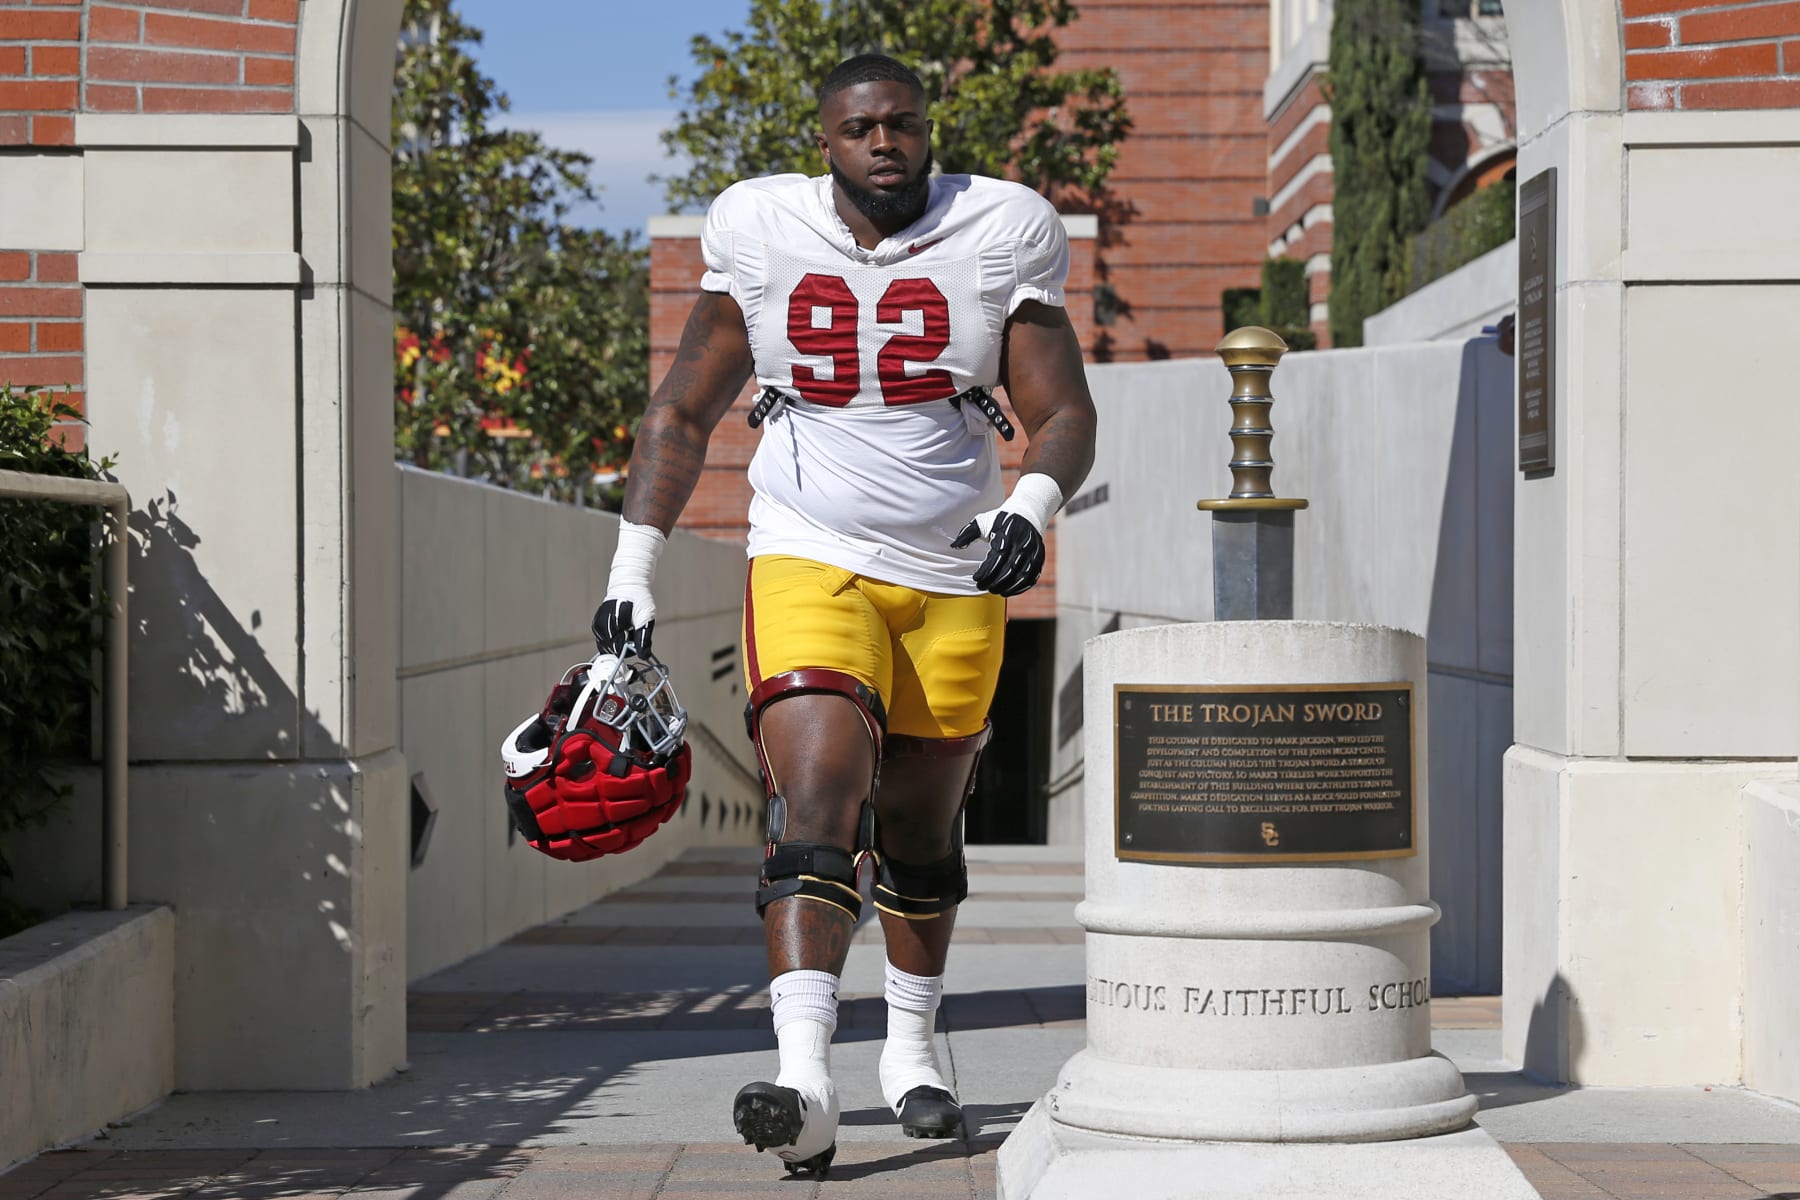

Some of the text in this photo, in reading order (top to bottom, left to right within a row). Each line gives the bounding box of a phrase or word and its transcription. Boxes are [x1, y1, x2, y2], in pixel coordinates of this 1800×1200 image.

[786, 273, 957, 408] 92
[1150, 702, 1384, 727] THE TROJAN SWORD
[1148, 736, 1165, 745] THIS
[1166, 736, 1199, 745] COLUMN
[1202, 737, 1209, 745] IS
[1211, 737, 1259, 745] DEDICATED
[1261, 736, 1273, 745] TO
[1275, 736, 1298, 745] MARK
[1337, 735, 1356, 744] WHO
[1371, 735, 1384, 743] THE
[1147, 748, 1200, 756] DEVELOPMENT
[1201, 748, 1220, 756] AND
[1221, 748, 1276, 756] COMPLETION
[1278, 748, 1290, 756] OF
[1291, 747, 1307, 756] THE
[1309, 747, 1331, 756] JOHN
[1147, 759, 1164, 768] JUST
[1165, 759, 1173, 768] AS
[1174, 759, 1189, 768] THE
[1191, 759, 1227, 768] COLUMN
[1229, 759, 1258, 768] HOLDS
[1259, 759, 1276, 768] THE
[1278, 759, 1309, 768] TROJAN
[1341, 758, 1348, 767] A
[1376, 758, 1385, 766] OF
[1178, 770, 1195, 779] AND
[1236, 770, 1247, 780] SO
[1280, 769, 1314, 779] TIRELESS
[1317, 769, 1340, 778] WORK
[1381, 768, 1393, 777] THE
[1198, 782, 1208, 790] OF
[1210, 782, 1230, 790] THIS
[1232, 782, 1274, 790] BUILDING
[1276, 781, 1304, 790] WHERE
[1322, 780, 1358, 789] ATHLETES
[1210, 793, 1263, 801] DEDICATION
[1265, 793, 1293, 801] SERVES
[1294, 792, 1304, 800] AS
[1305, 792, 1311, 800] A
[1139, 804, 1153, 812] FOR
[1153, 804, 1170, 812] THIS
[1171, 804, 1203, 812] LASTING
[1205, 804, 1224, 813] CALL
[1227, 805, 1238, 813] TO
[1240, 804, 1289, 813] EXCELLENCE
[1292, 804, 1309, 812] FOR
[1311, 803, 1335, 812] EVERY
[1335, 803, 1361, 811] TROJAN
[1183, 987, 1352, 1016] FAITHFUL
